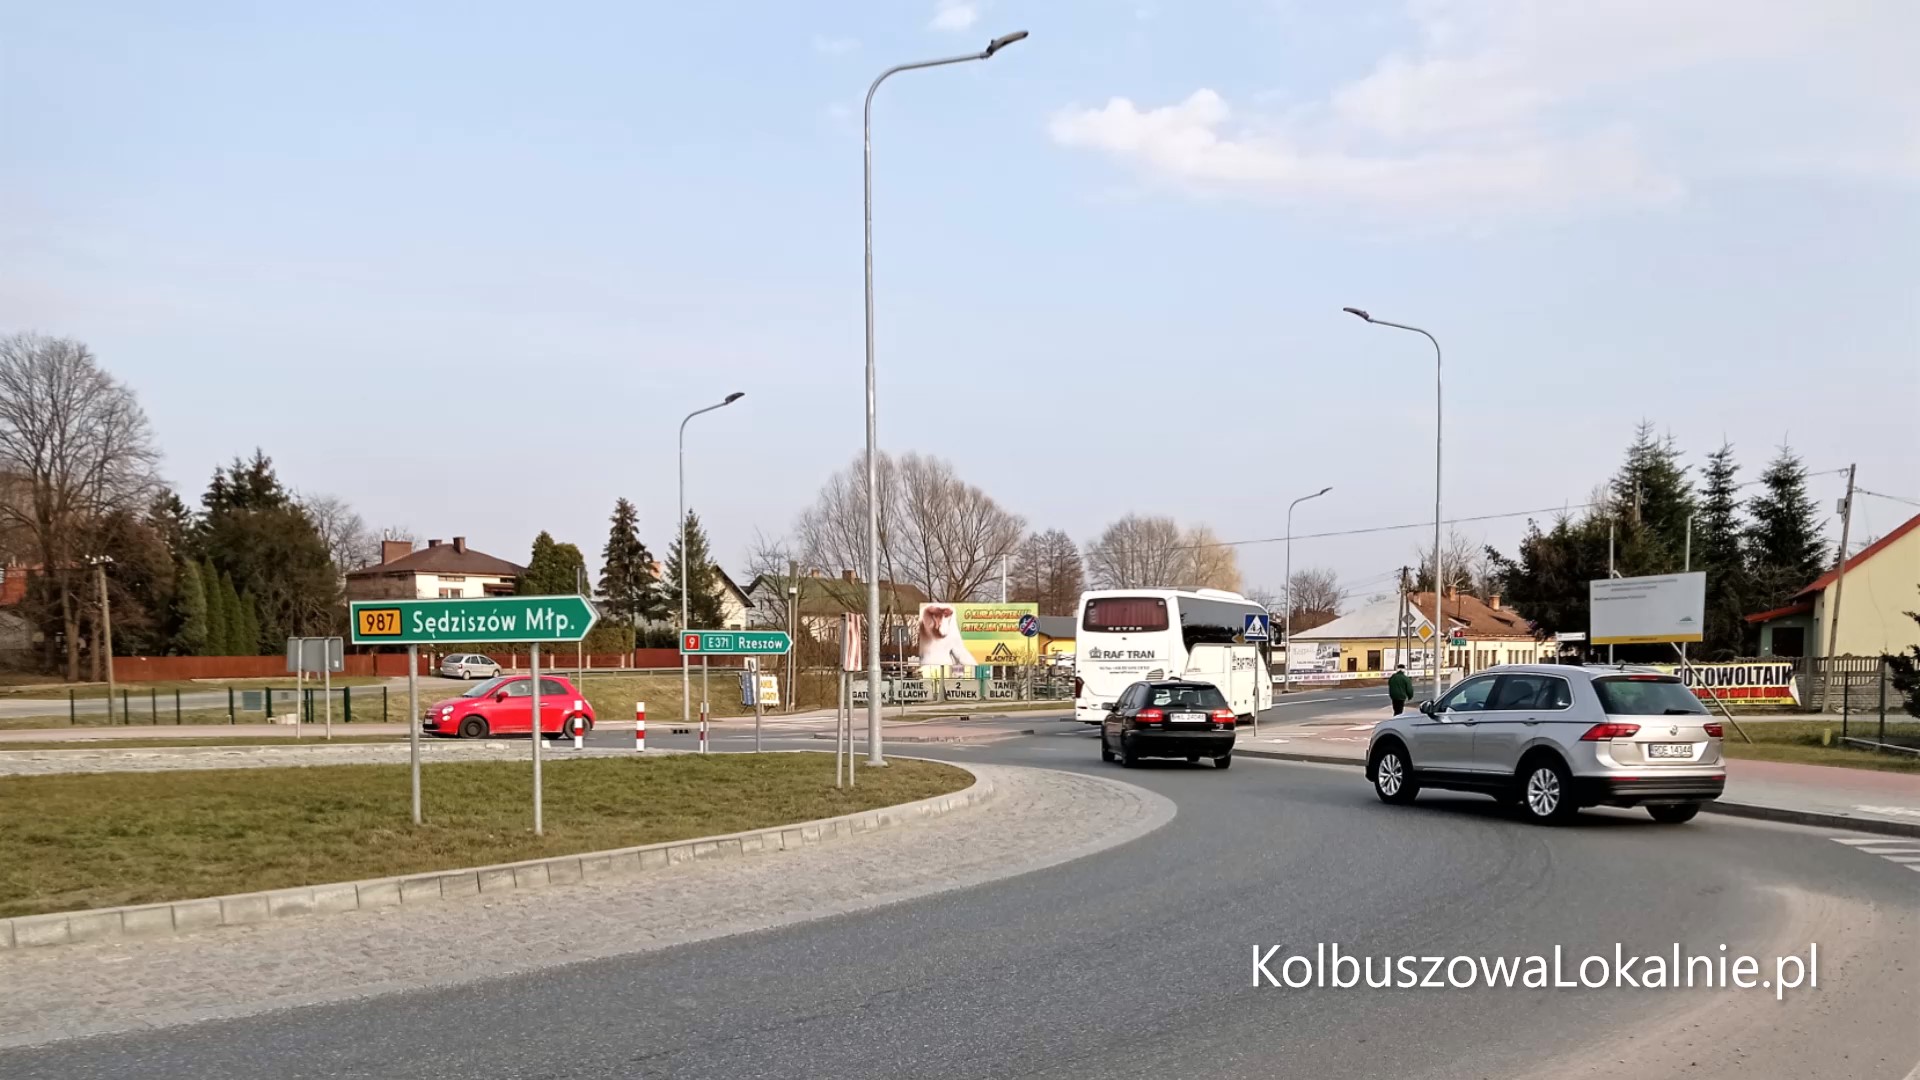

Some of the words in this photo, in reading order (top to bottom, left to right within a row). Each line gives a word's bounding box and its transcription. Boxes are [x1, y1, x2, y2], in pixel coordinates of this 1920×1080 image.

[366, 613, 394, 631] 987
[412, 609, 516, 639] Sędziszów
[526, 607, 575, 637] Młp.
[688, 637, 696, 648] 9
[738, 636, 783, 649] Rzeszów
[1103, 650, 1125, 659] RAF
[1126, 650, 1155, 659] TRAN
[955, 681, 961, 689] 2
[946, 690, 977, 698] ATUNEK
